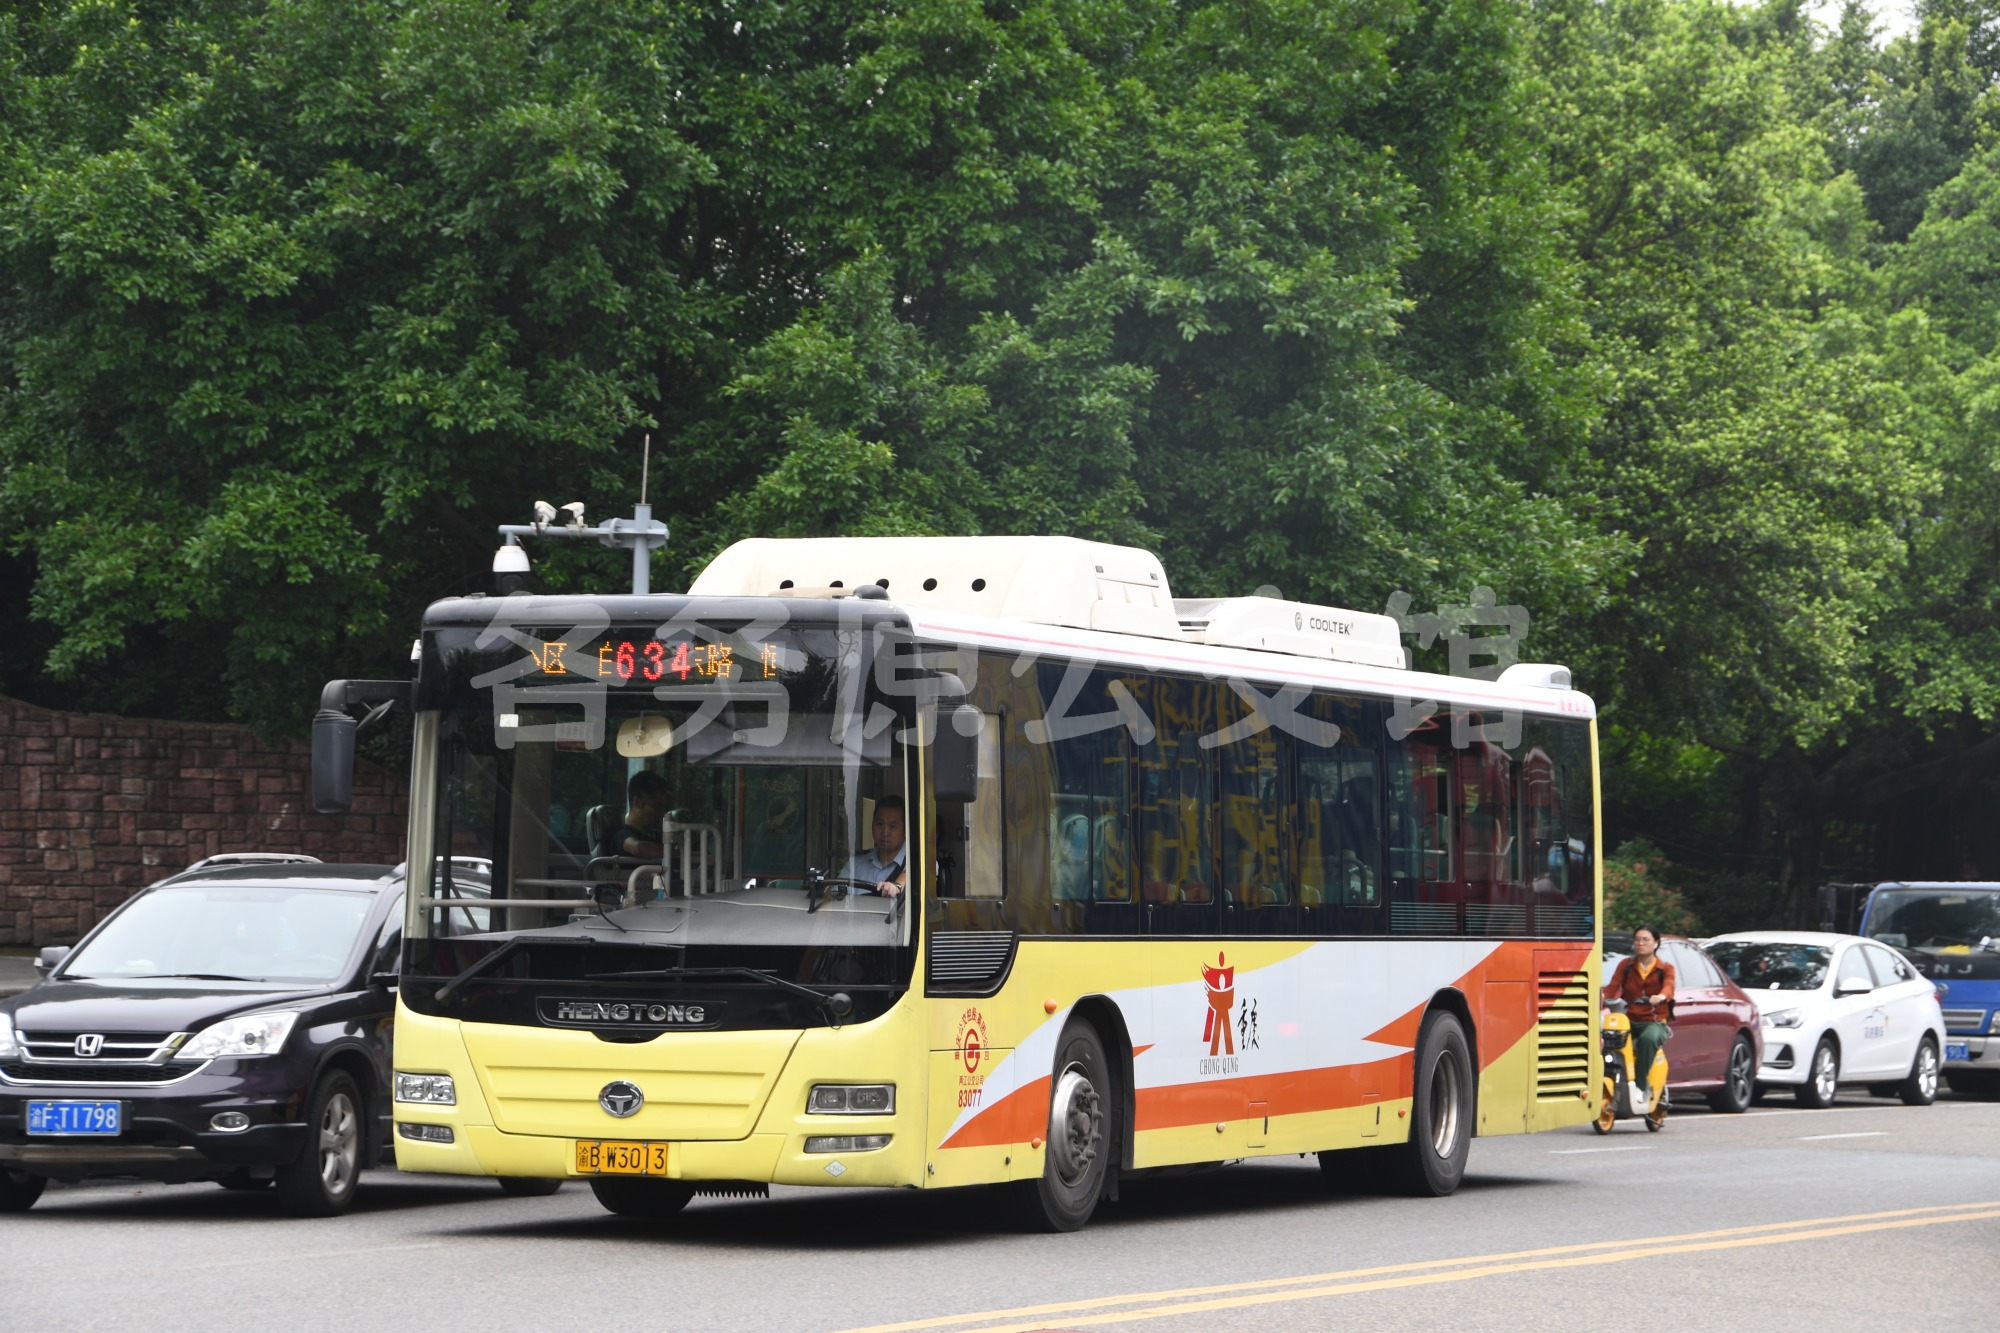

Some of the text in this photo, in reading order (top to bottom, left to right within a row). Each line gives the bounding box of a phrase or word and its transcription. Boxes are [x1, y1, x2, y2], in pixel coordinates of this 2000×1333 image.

[1309, 617, 1350, 635] COOLTEK
[615, 641, 692, 681] 634
[557, 1001, 705, 1023] HENGTONG
[1200, 1057, 1239, 1075] CHONG QING
[957, 1088, 982, 1108] 83077
